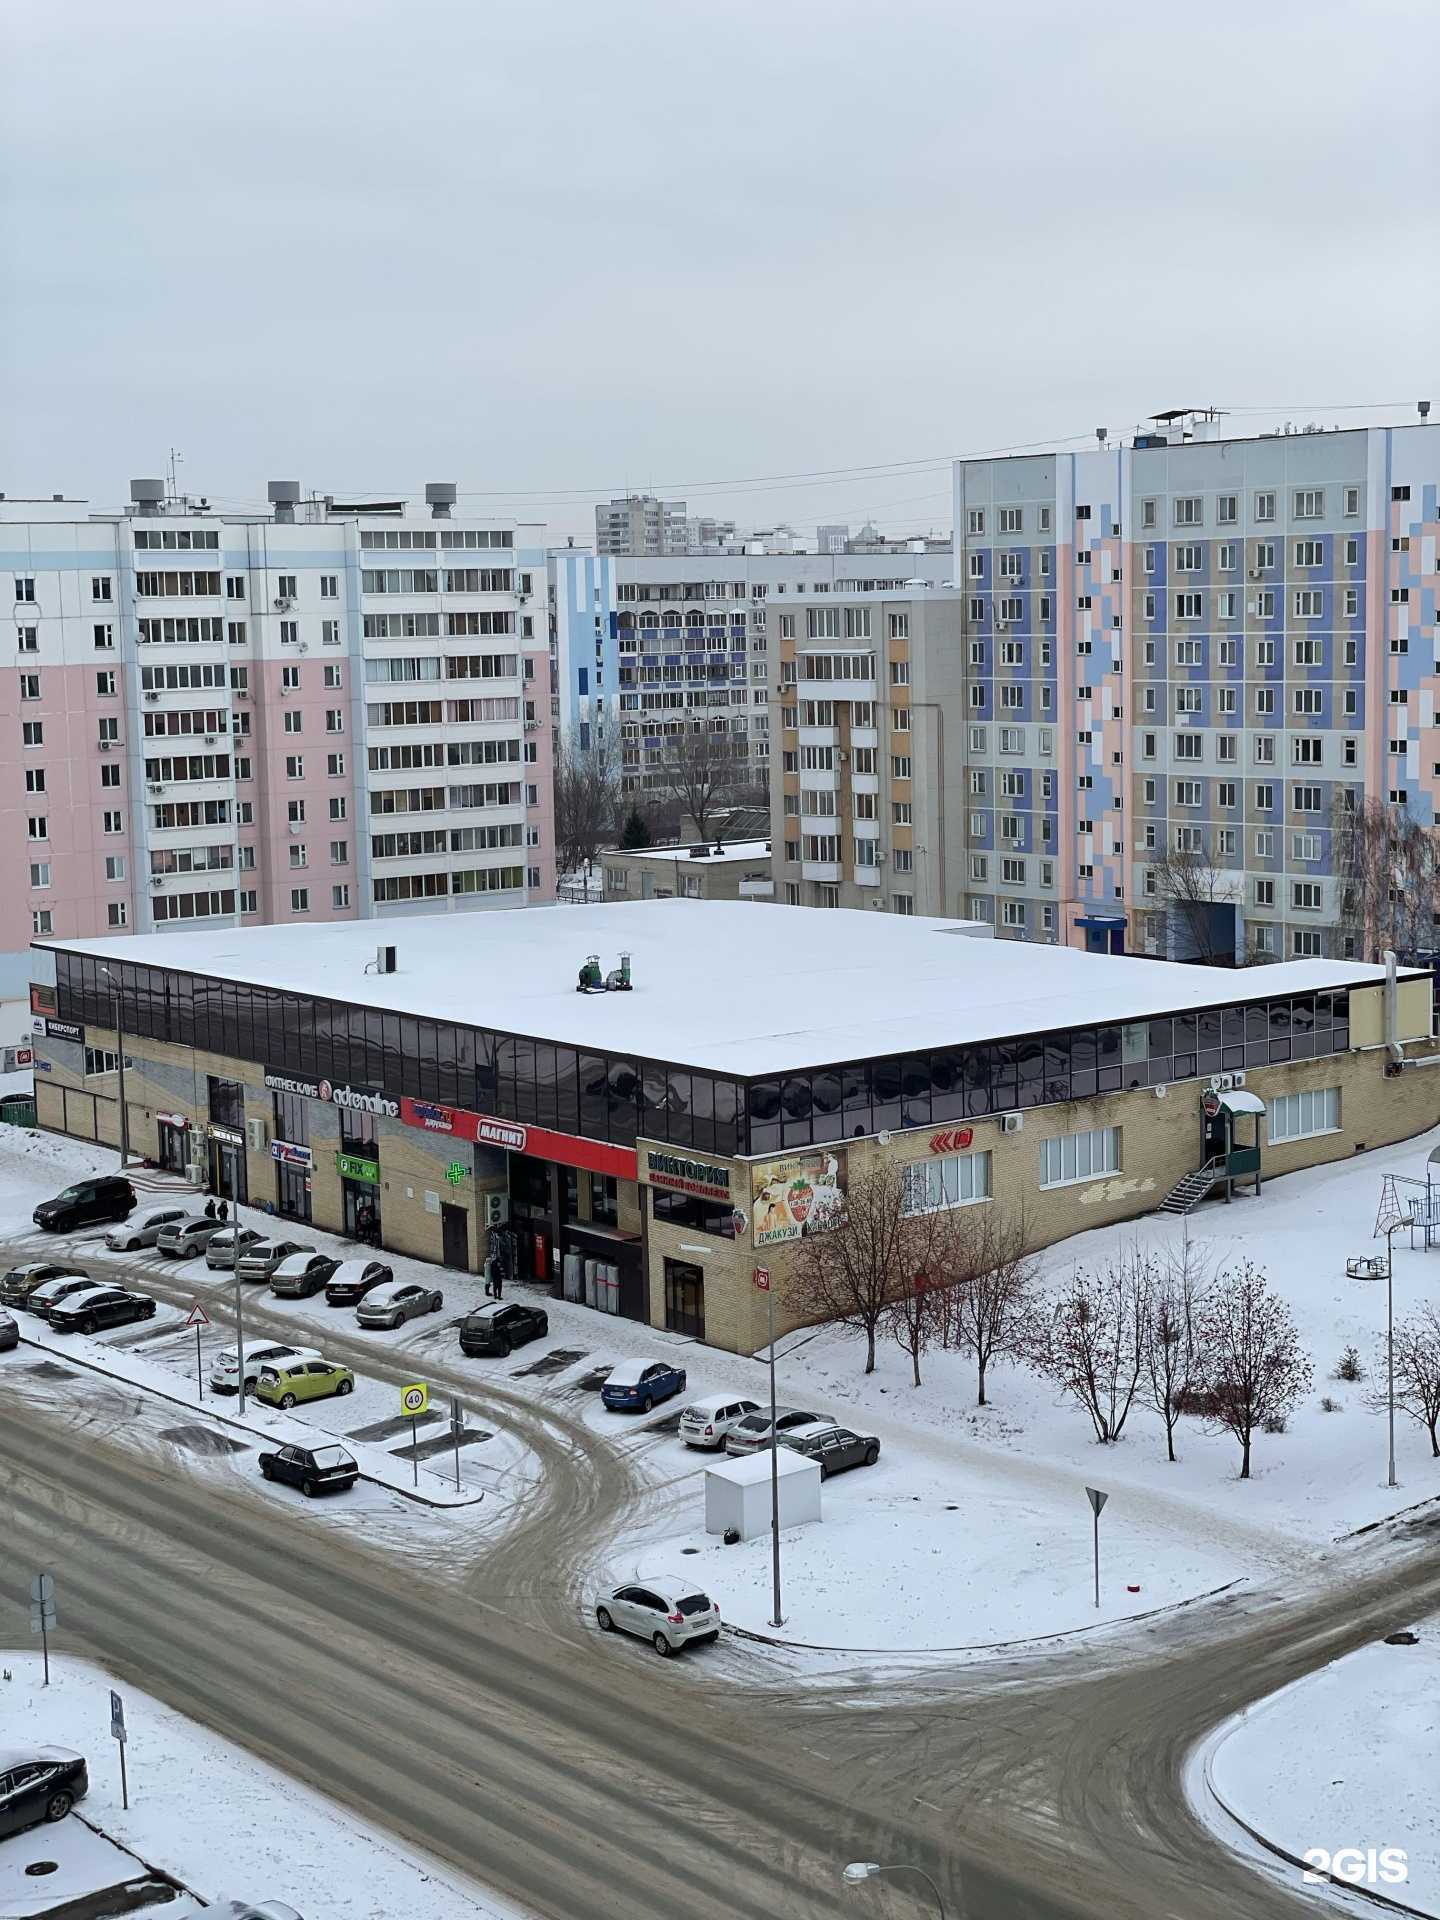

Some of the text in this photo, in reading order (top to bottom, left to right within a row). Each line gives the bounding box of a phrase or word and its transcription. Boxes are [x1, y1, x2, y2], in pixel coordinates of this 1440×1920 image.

[333, 1085, 399, 1117] adrenaline
[480, 1124, 523, 1146] МАГНИТ
[648, 1151, 730, 1188] ВИКТОРИЯ
[759, 1226, 798, 1244] ДЖАКУЗИ
